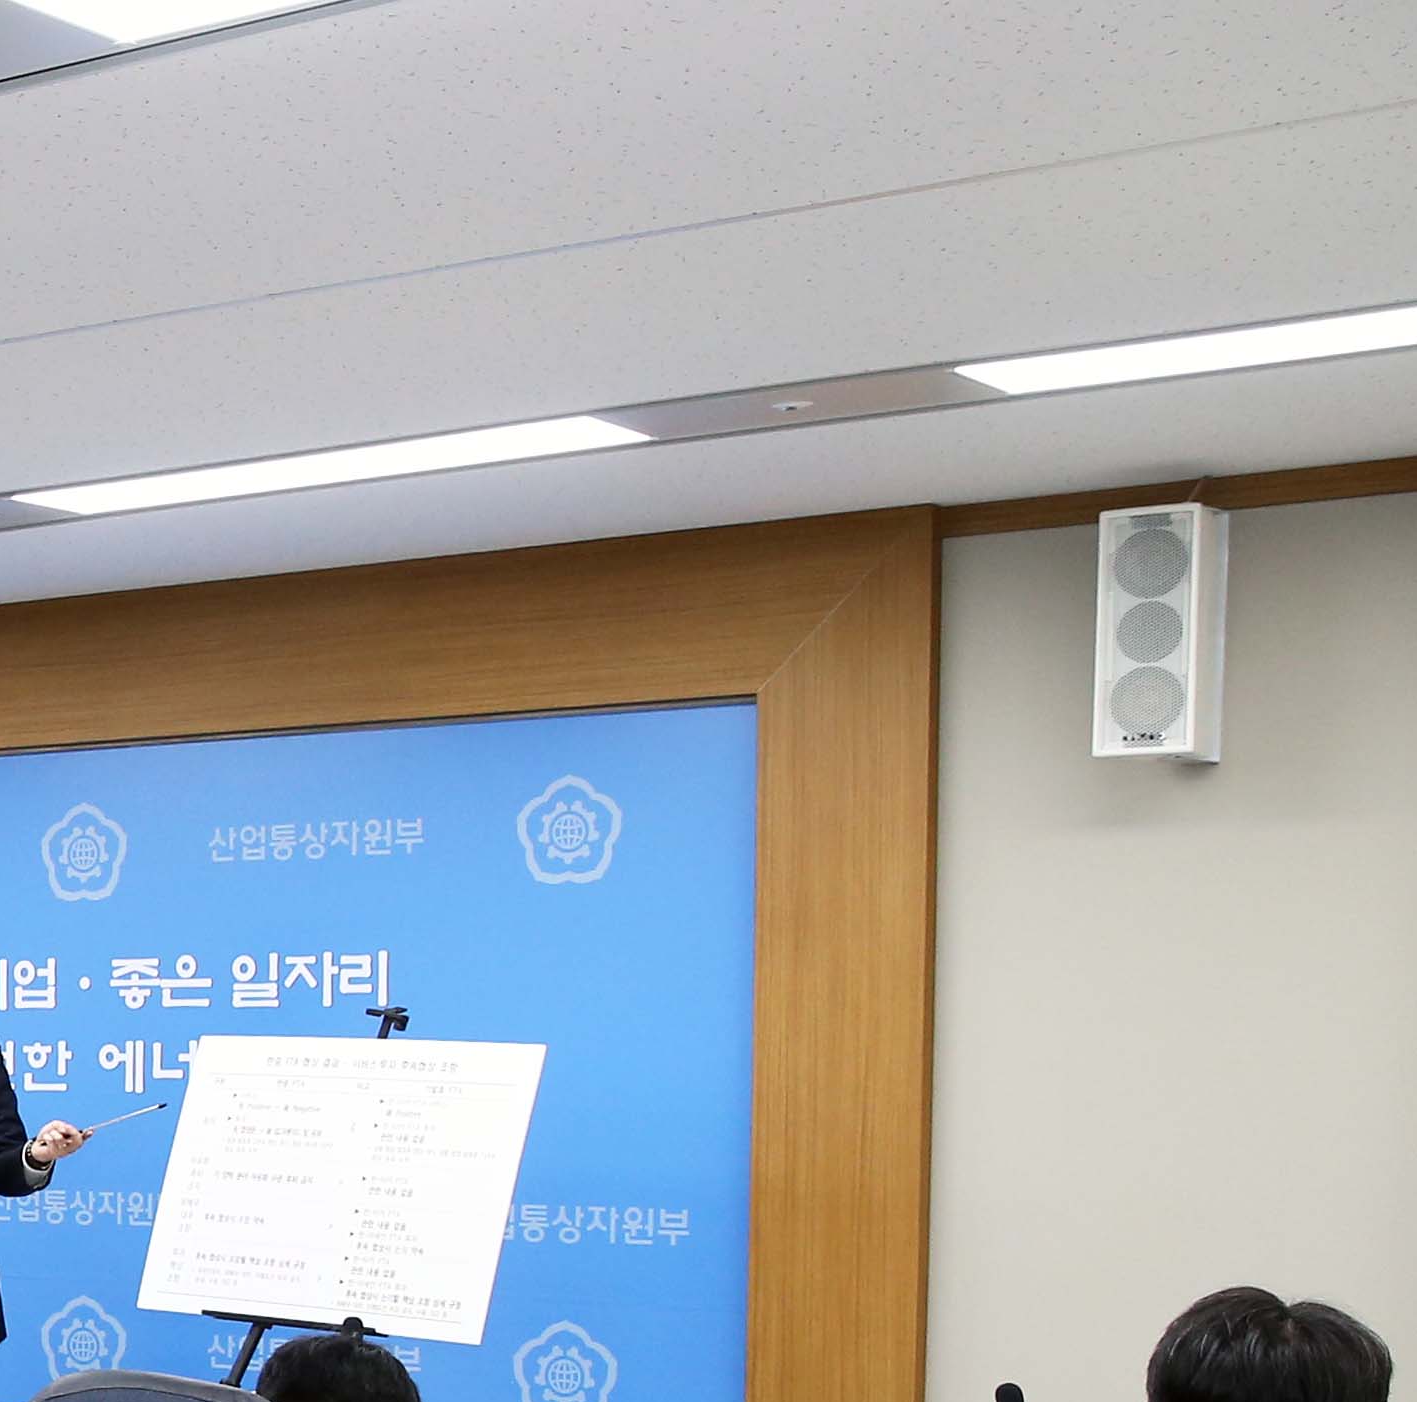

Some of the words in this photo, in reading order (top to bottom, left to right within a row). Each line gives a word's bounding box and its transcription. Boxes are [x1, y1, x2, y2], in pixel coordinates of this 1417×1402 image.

[208, 817, 425, 863] 산업통상자원부
[108, 954, 213, 1010] 좋은
[231, 949, 390, 1008] 일자리
[97, 1038, 198, 1094] 에너
[503, 1203, 691, 1246] 통상자원부
